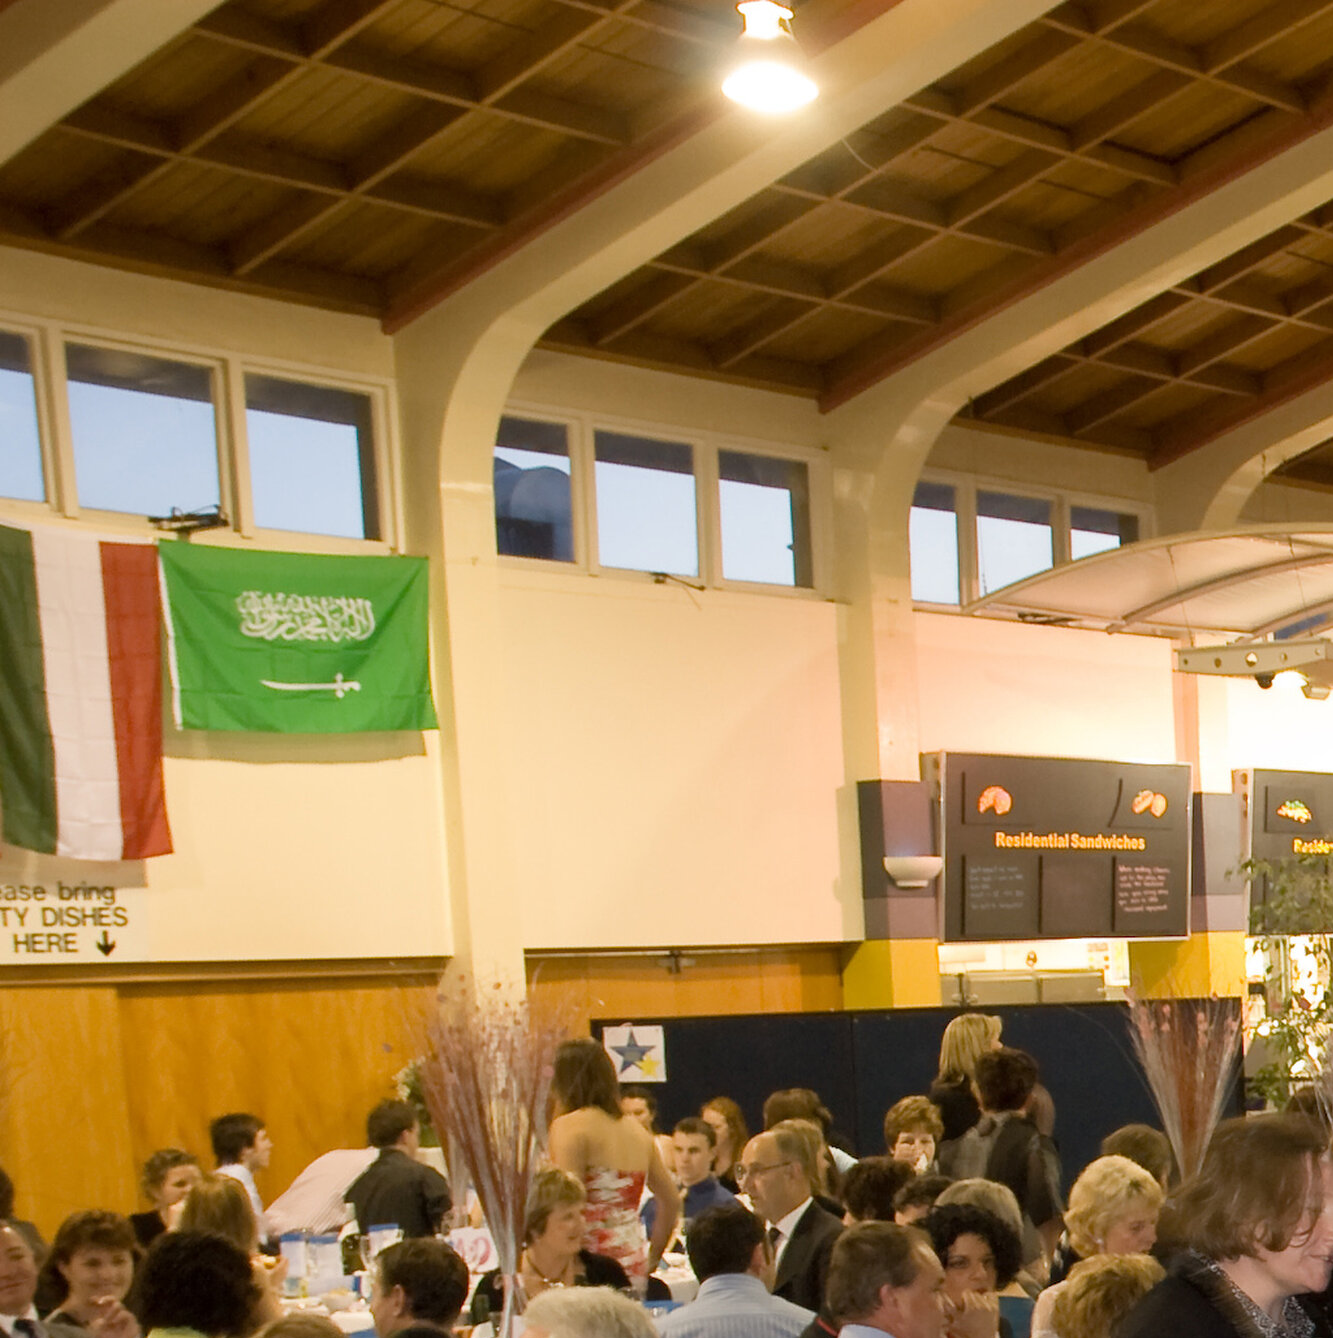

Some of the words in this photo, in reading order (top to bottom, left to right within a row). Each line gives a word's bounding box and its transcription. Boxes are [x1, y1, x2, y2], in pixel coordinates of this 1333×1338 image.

[995, 832, 1069, 849] Residential
[1071, 833, 1145, 850] Sandwiches
[0, 885, 46, 901] ase
[58, 881, 115, 905] bring
[42, 907, 128, 927] DISHES
[13, 933, 78, 953] HERE
